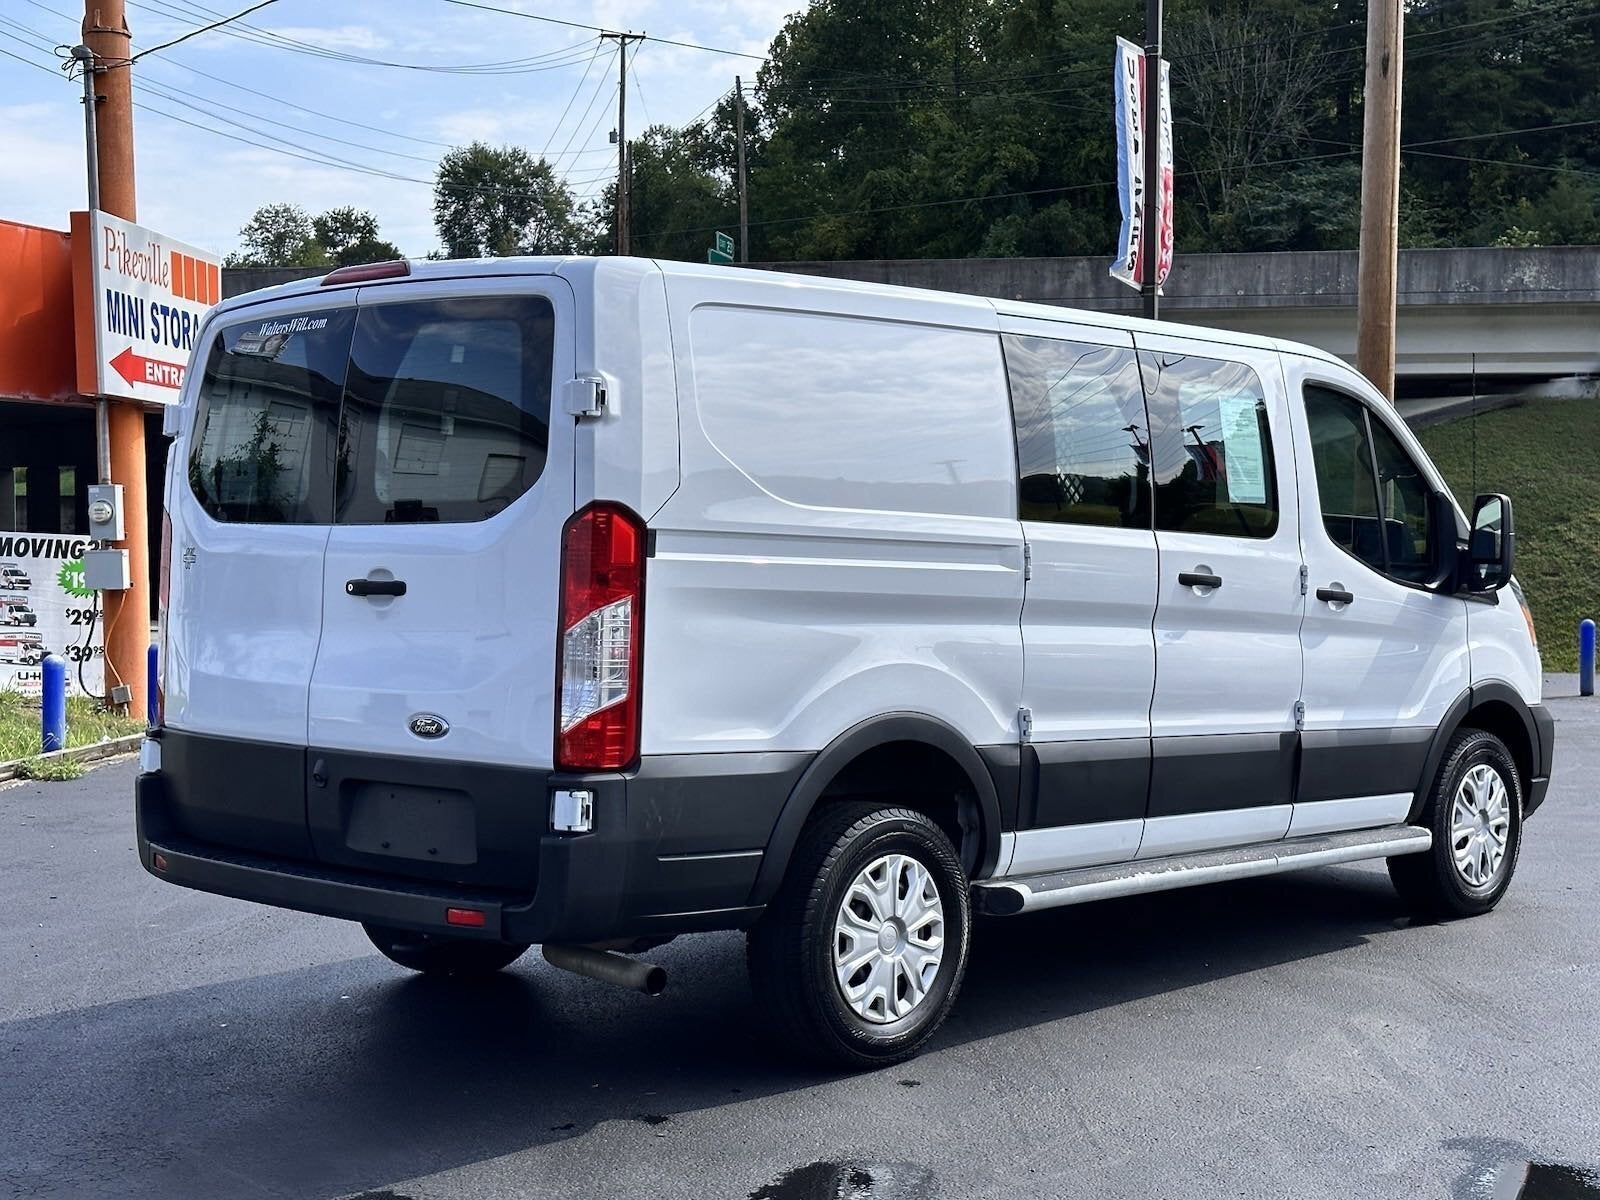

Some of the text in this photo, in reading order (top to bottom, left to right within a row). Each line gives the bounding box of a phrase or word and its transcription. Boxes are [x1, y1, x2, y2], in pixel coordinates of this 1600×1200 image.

[104, 226, 169, 288] Pikeville
[106, 288, 145, 340] MINI
[259, 316, 328, 336] WaltersWill.com
[415, 719, 438, 733] Ford
